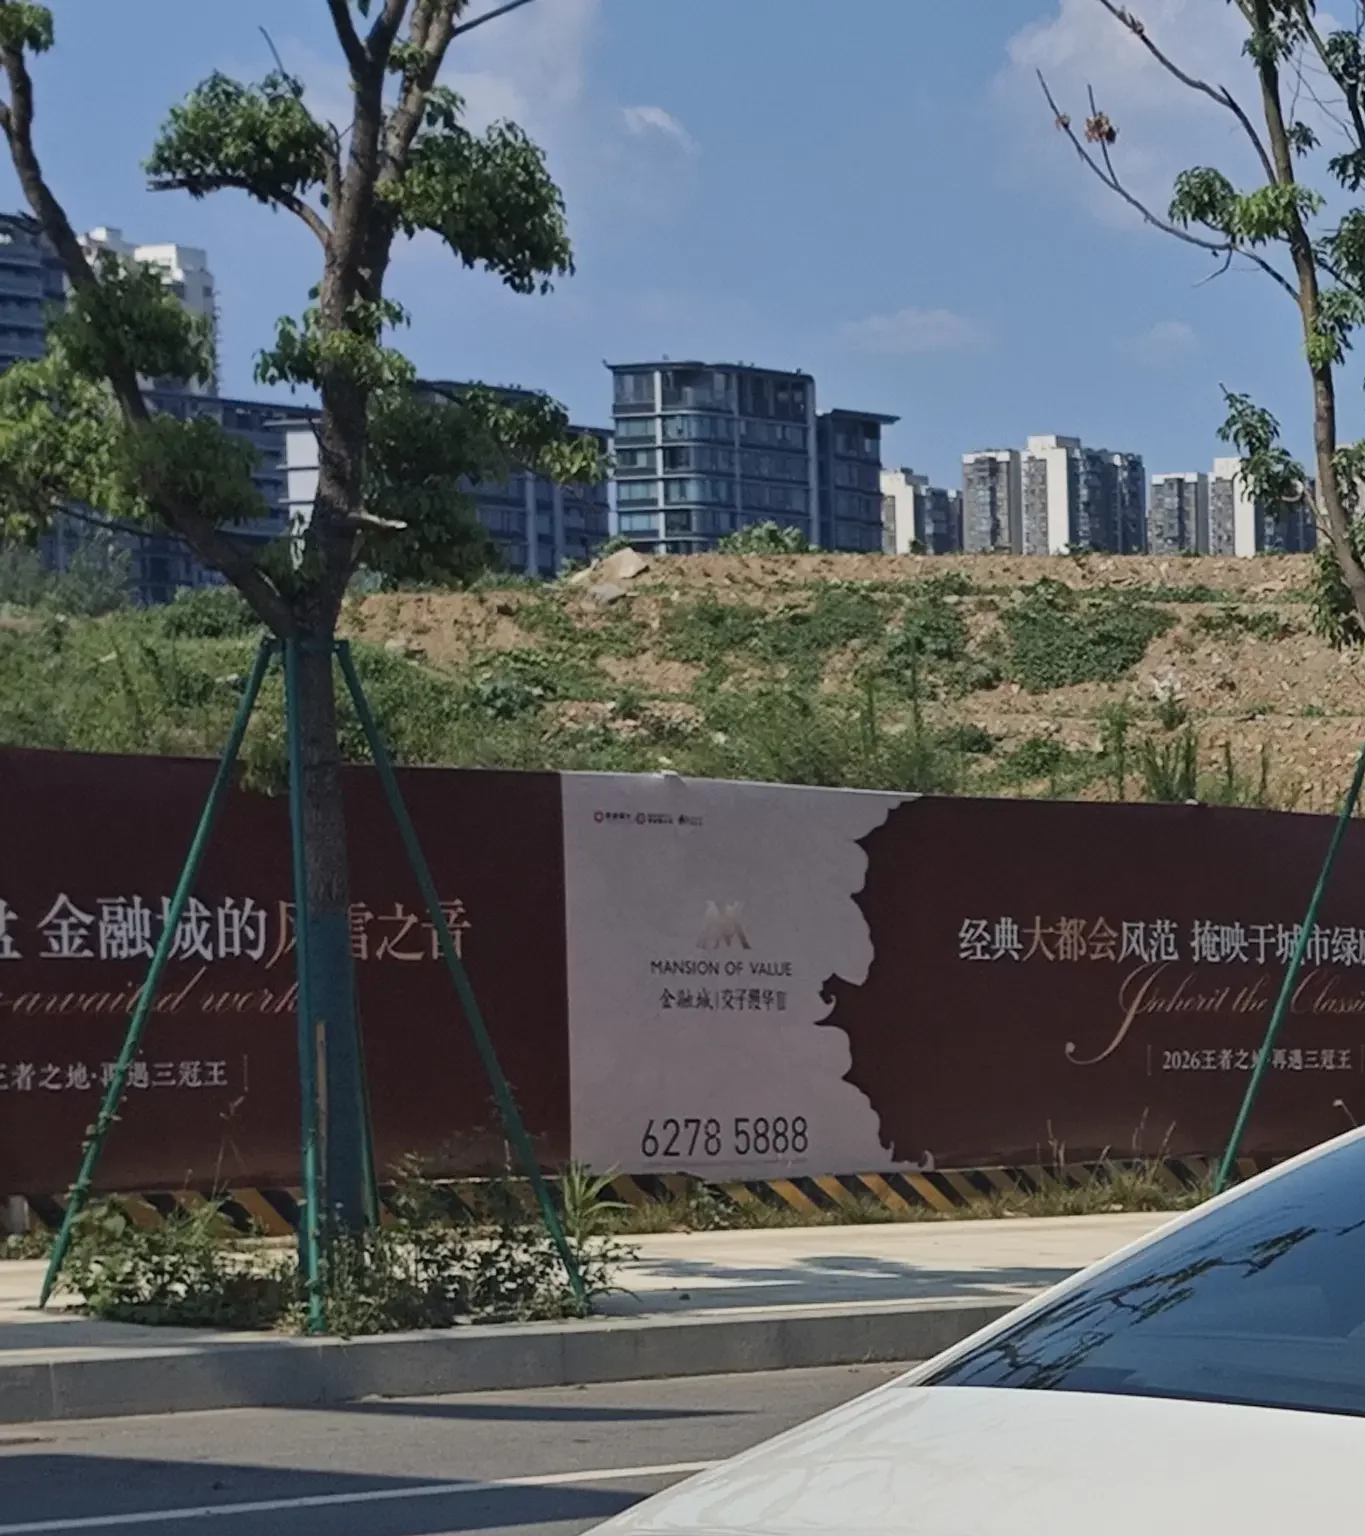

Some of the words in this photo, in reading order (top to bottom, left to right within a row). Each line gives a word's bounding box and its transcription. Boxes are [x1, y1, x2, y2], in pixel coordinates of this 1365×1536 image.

[958, 915, 1181, 963] 经典大都会风范
[651, 960, 720, 976] MANSION
[725, 960, 744, 976] OF
[750, 961, 793, 977] VALUE
[641, 1119, 722, 1157] 6278
[734, 1117, 809, 1156] 5888
